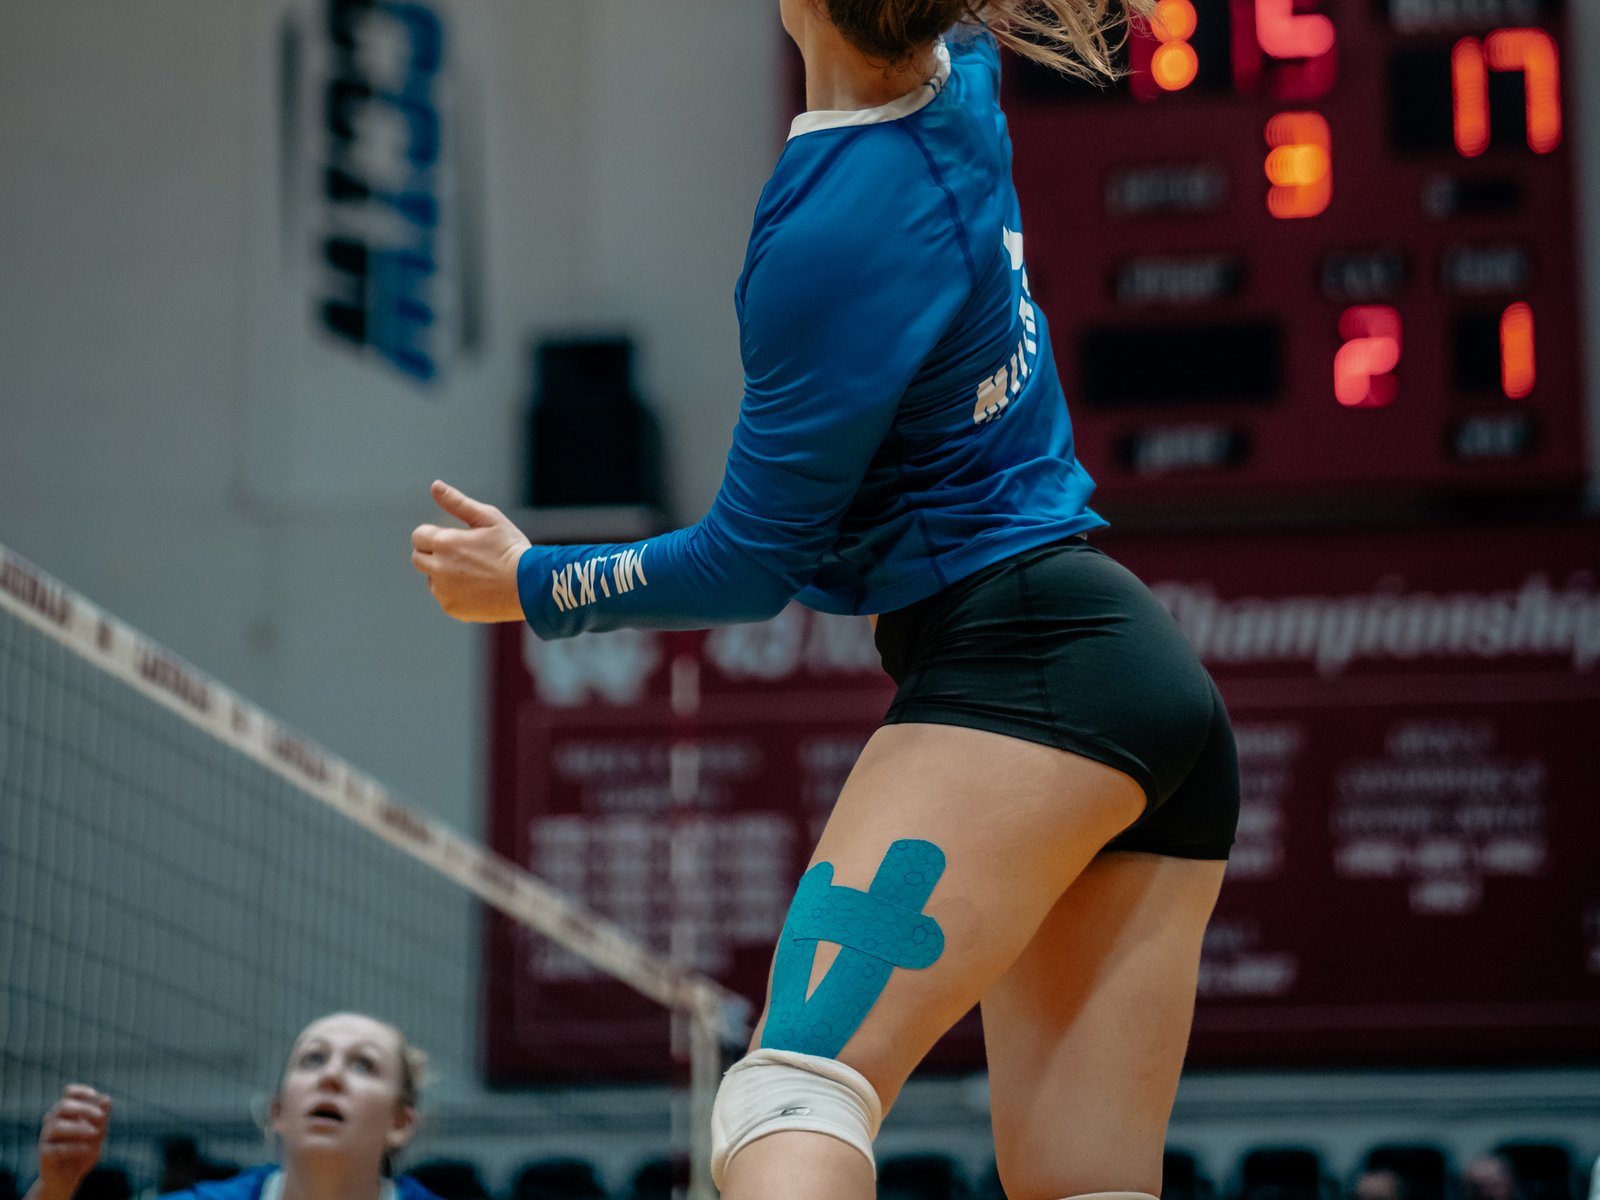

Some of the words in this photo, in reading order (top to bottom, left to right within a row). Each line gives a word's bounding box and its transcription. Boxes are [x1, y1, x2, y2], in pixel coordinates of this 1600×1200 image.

[1451, 27, 1561, 157] 17
[1335, 305, 1402, 407] 2
[1501, 301, 1536, 399] 1
[552, 543, 648, 612] MILLIKIN
